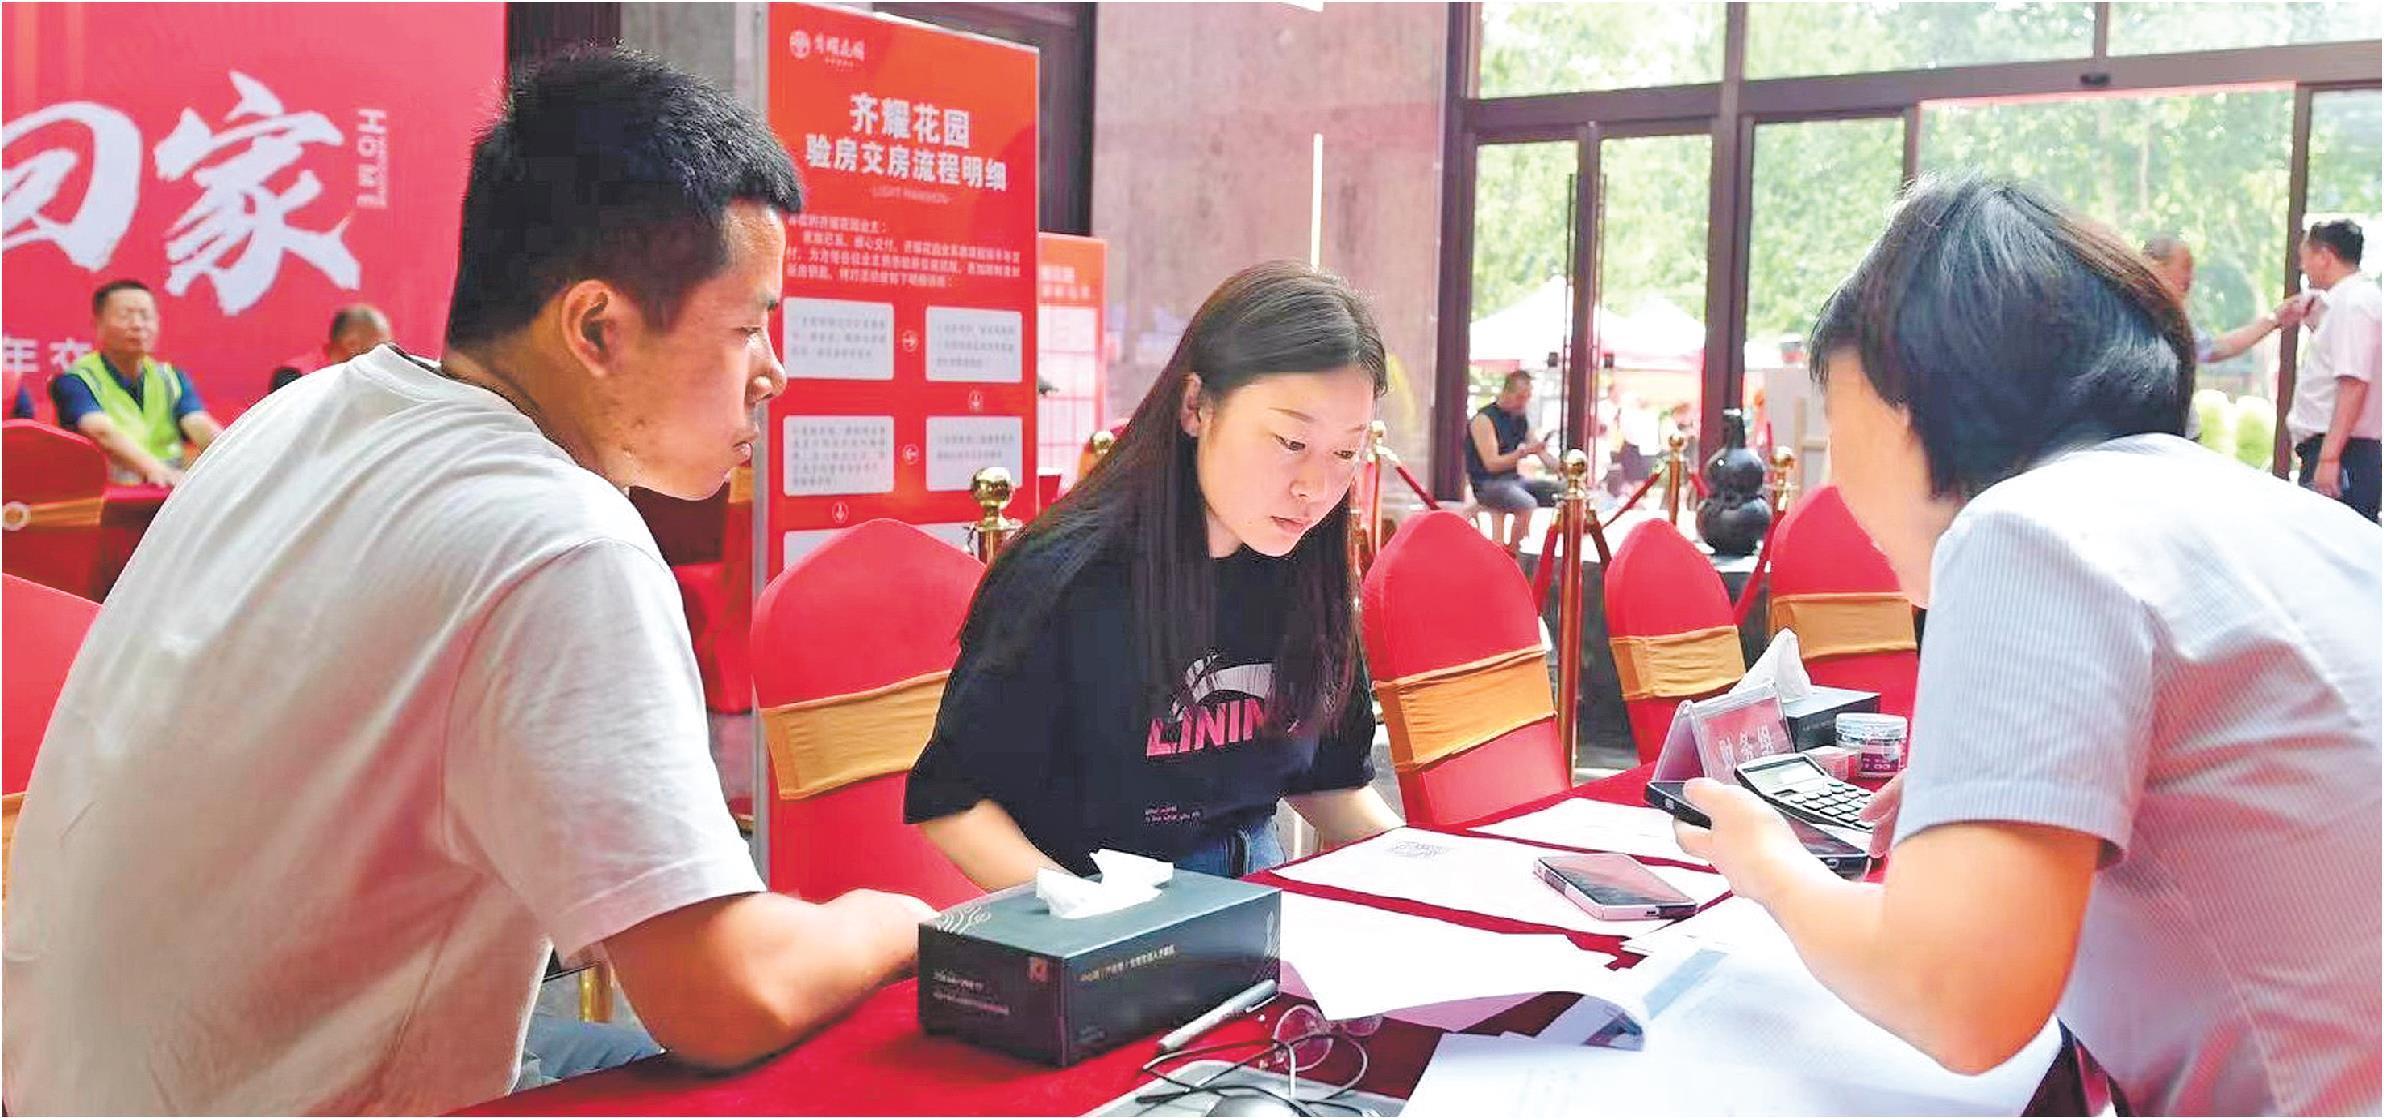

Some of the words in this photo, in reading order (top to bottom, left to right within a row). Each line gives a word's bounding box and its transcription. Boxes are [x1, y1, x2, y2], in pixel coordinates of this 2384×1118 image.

[850, 92, 970, 149] 齐耀花园
[806, 133, 1007, 192] 验房交房流程明细
[1146, 697, 1300, 759] LININ
